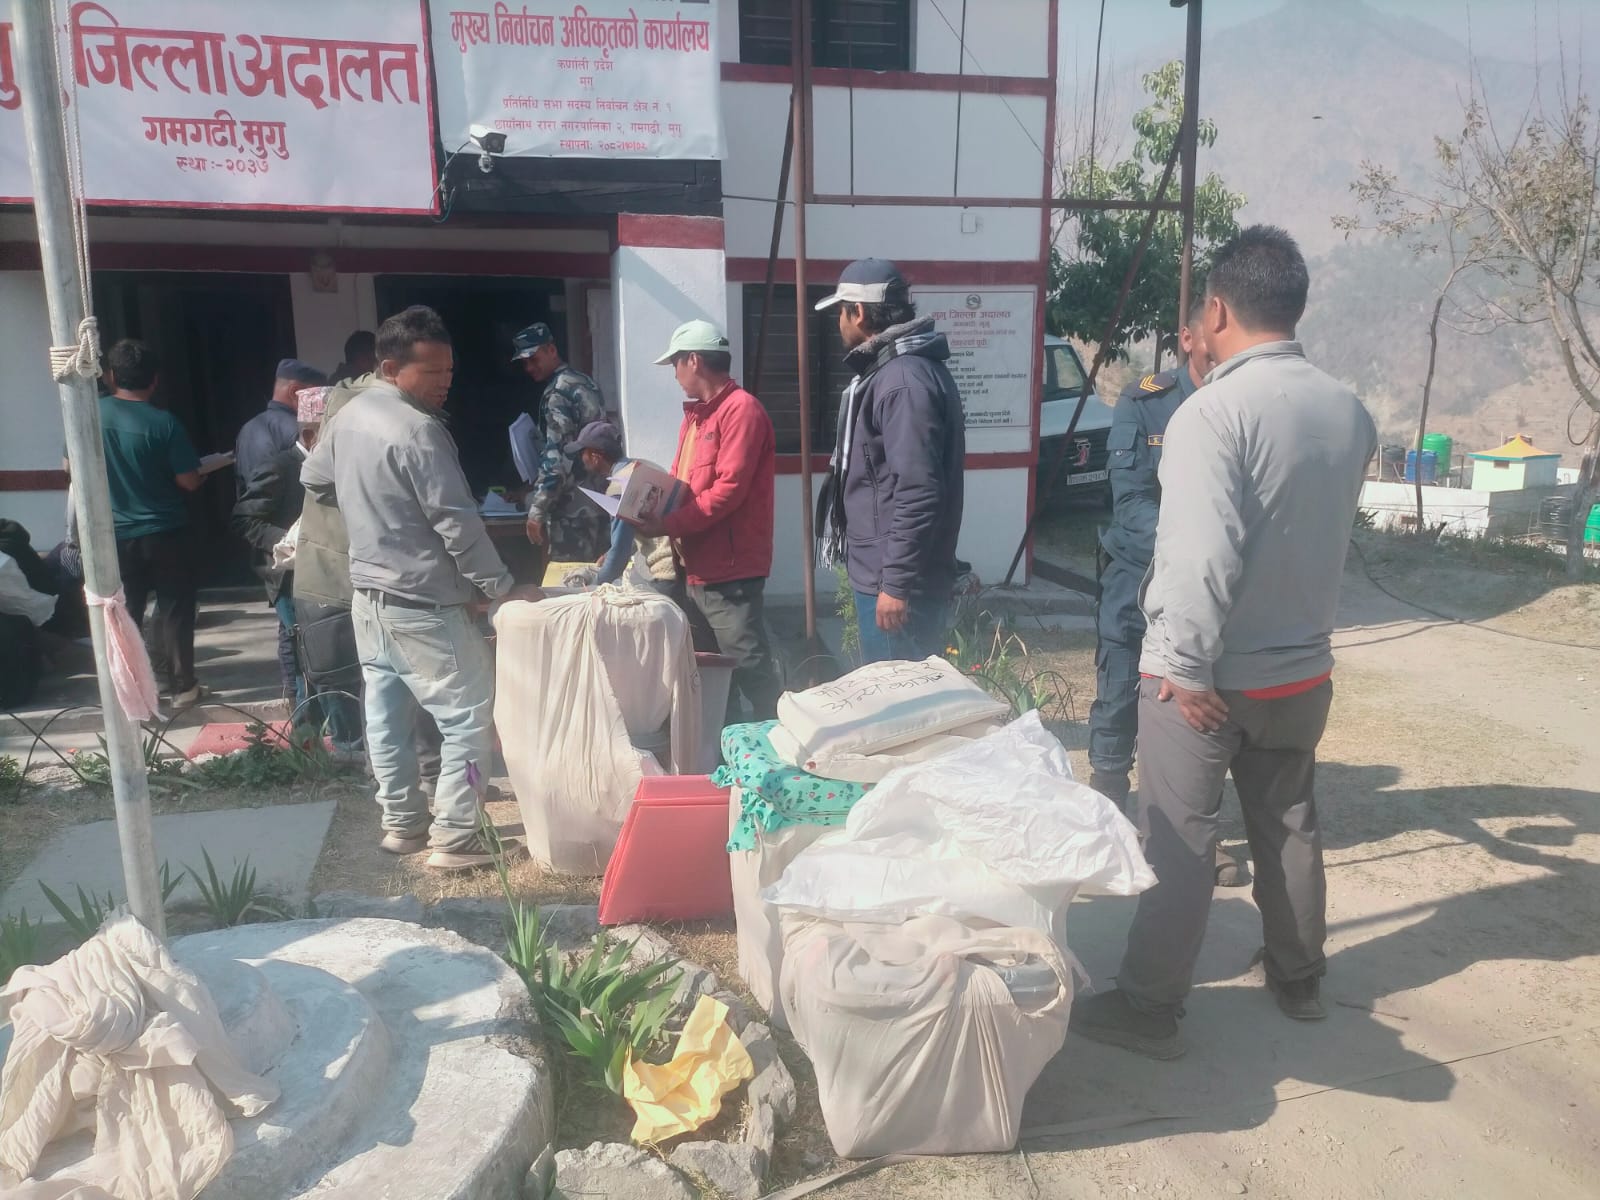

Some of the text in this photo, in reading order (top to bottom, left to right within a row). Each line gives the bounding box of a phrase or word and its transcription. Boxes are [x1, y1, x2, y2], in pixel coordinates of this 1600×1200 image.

[449, 2, 710, 58] मुख्य निर्वाचन अधिकृतको कार्यालय
